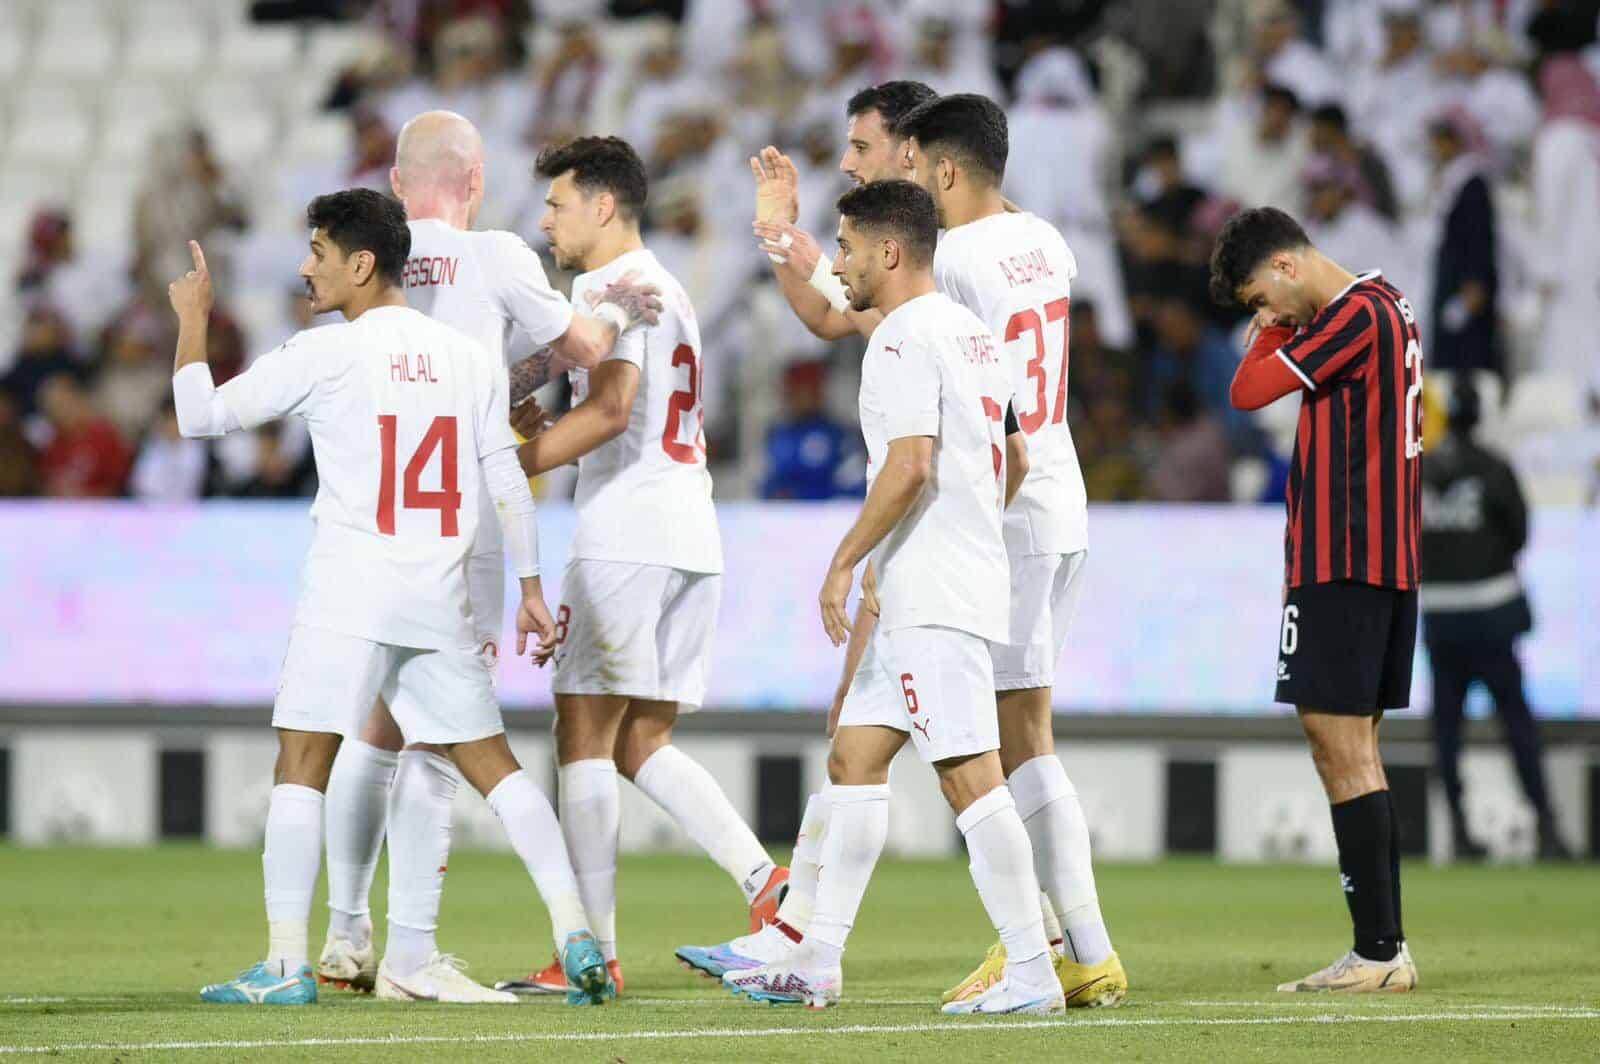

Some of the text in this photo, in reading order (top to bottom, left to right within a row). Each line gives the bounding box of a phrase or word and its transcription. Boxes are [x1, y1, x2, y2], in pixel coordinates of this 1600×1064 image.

[390, 353, 439, 383] HILAL
[662, 343, 706, 464] 2
[1004, 297, 1070, 435] 37
[376, 415, 462, 537] 14
[1280, 604, 1300, 655] 6
[900, 672, 919, 715] 6
